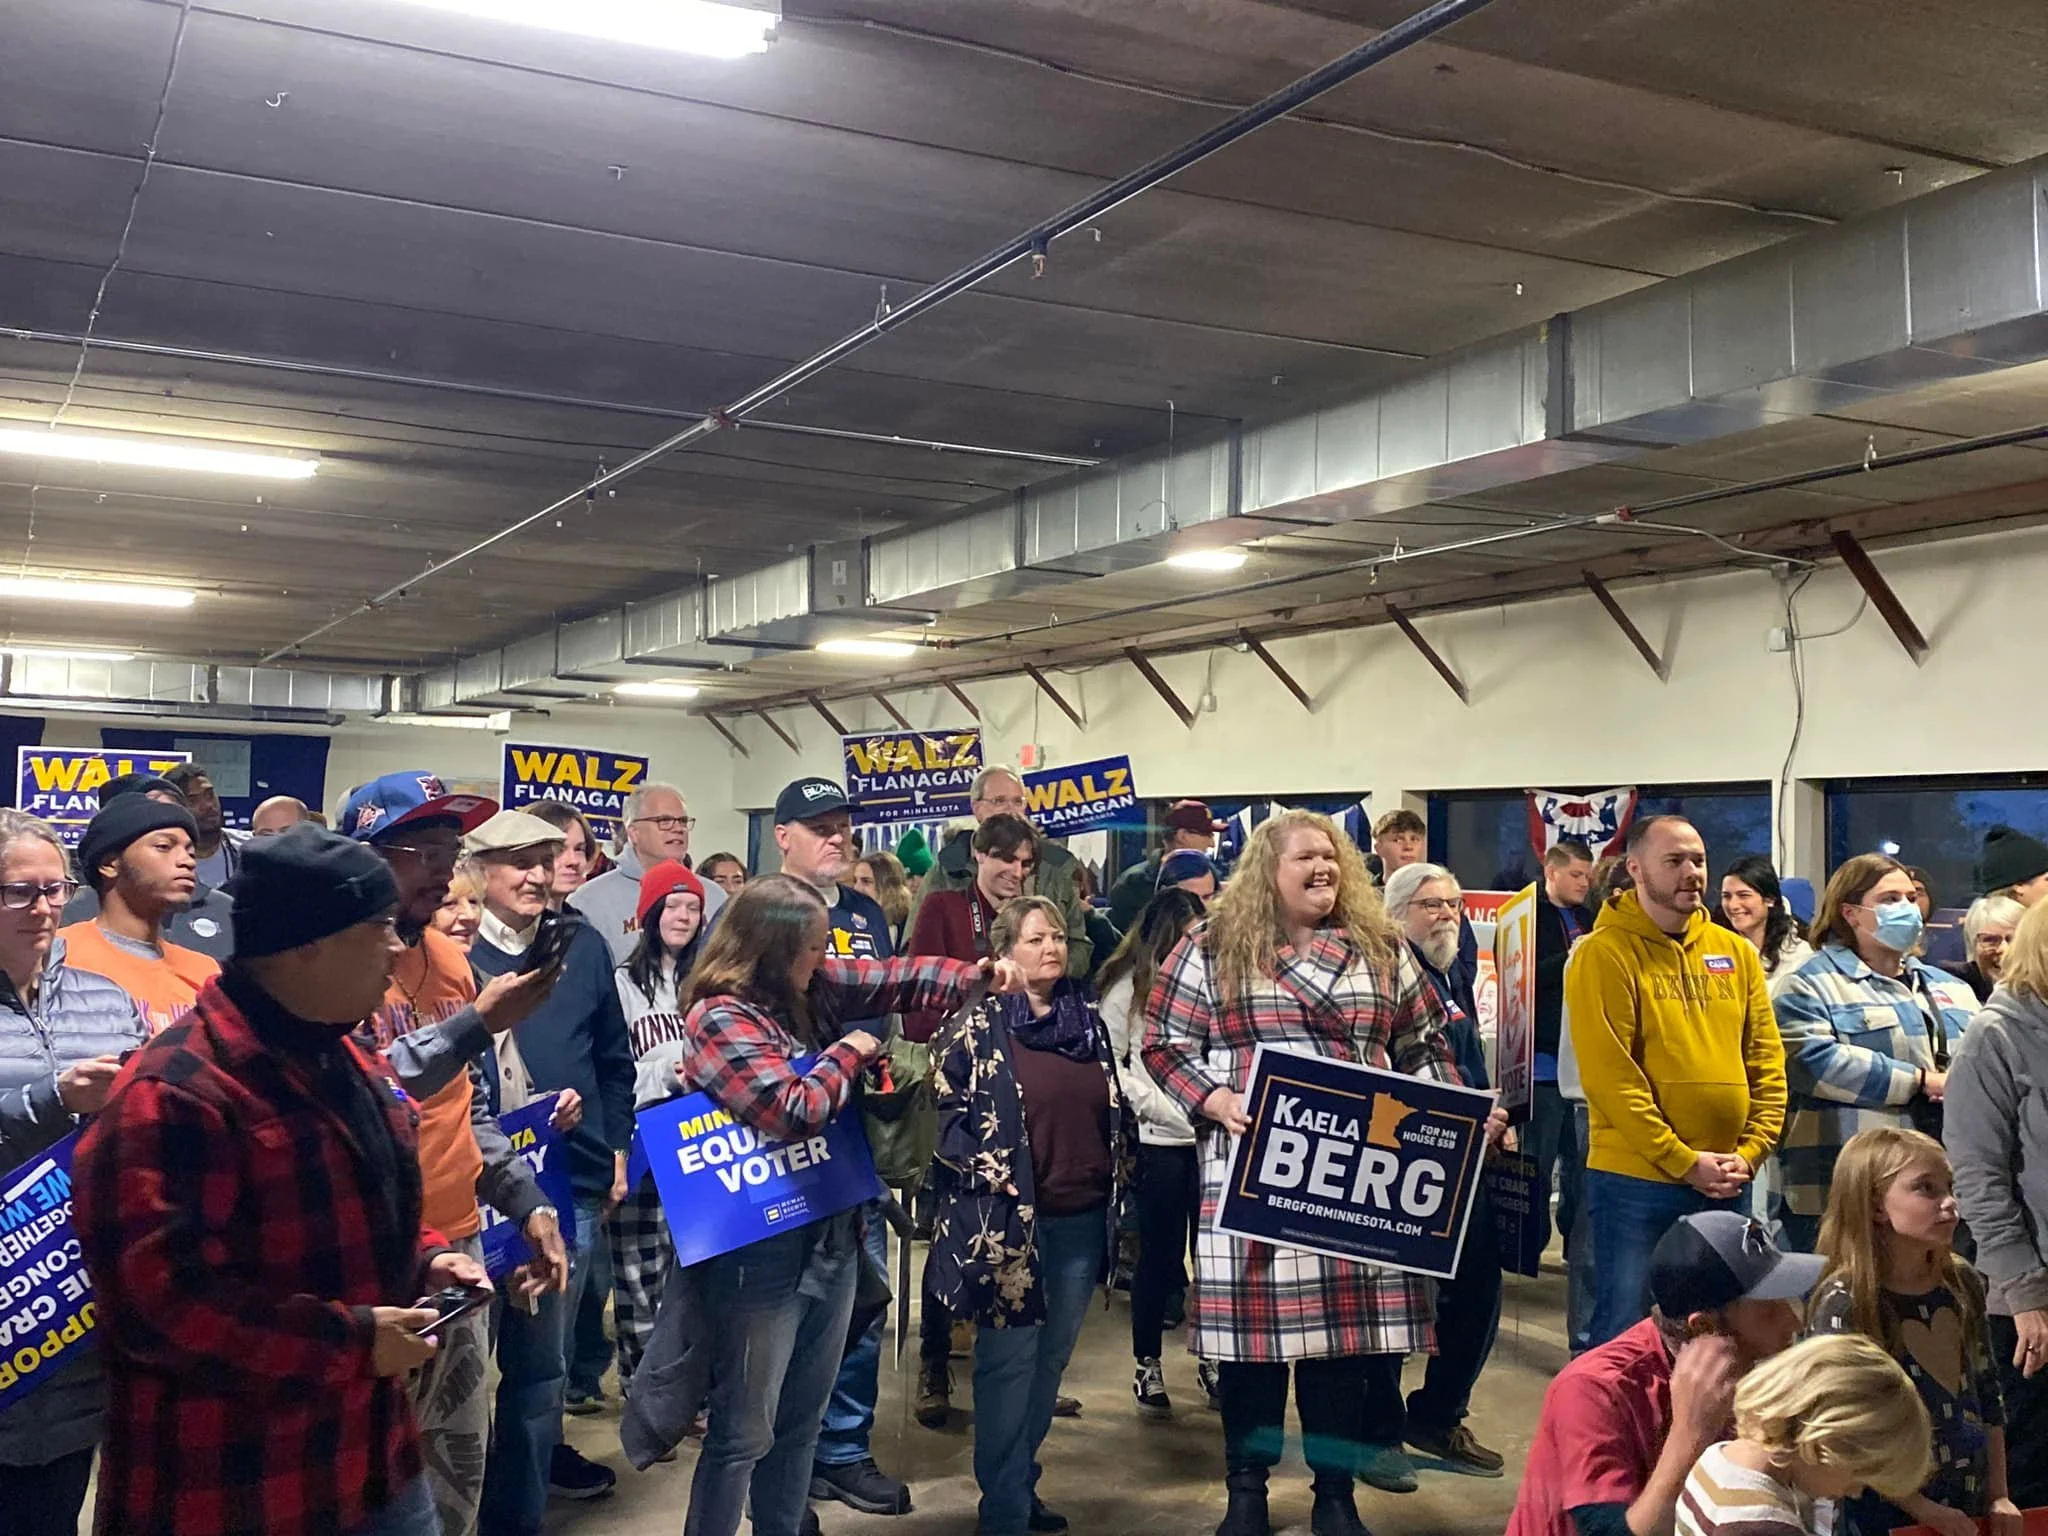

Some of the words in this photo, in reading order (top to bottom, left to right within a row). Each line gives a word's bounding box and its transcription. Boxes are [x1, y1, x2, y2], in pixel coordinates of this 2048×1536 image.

[851, 734, 978, 774] WALZ
[511, 750, 642, 793] WALZ
[857, 769, 977, 792] FLANAGAN
[33, 794, 100, 811] FLAN
[515, 784, 630, 809] FLANAGA
[1025, 768, 1131, 812] WALZ
[903, 804, 960, 816] MINNESOTA
[1029, 794, 1134, 825] FLANAGAN
[1464, 907, 1497, 923] ANG
[1502, 1065, 1526, 1096] VOTE
[1273, 1094, 1360, 1141] KAELA
[1420, 1124, 1440, 1138] FOR
[1441, 1128, 1458, 1139] MN
[1403, 1131, 1437, 1147] HOUSE
[716, 1136, 831, 1193] VOTER
[1258, 1127, 1446, 1217] BERG
[1267, 1195, 1423, 1237] BERGFORMINNESOTA.COM
